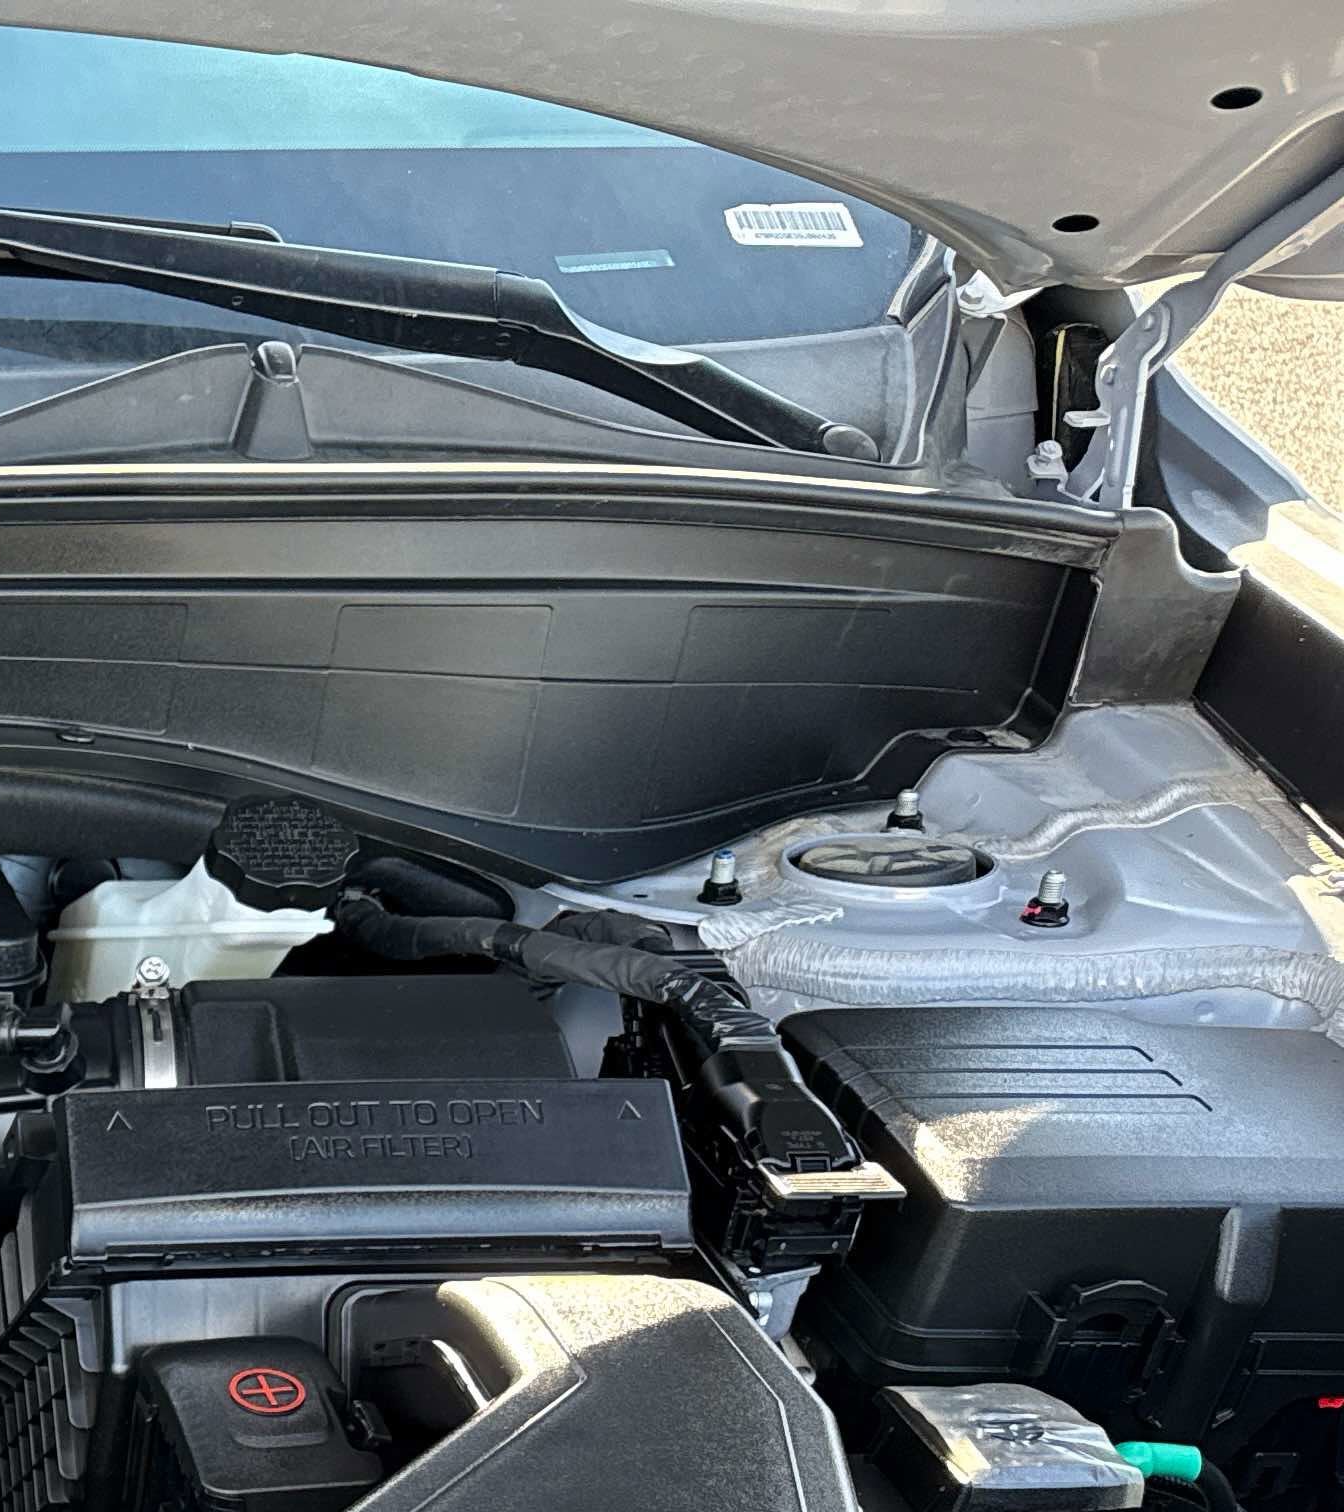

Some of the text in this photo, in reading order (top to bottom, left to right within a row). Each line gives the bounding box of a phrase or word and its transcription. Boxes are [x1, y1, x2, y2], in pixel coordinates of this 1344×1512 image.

[205, 1099, 544, 1130] PULL OUT TO OPEN
[360, 1134, 473, 1159] FILTER)
